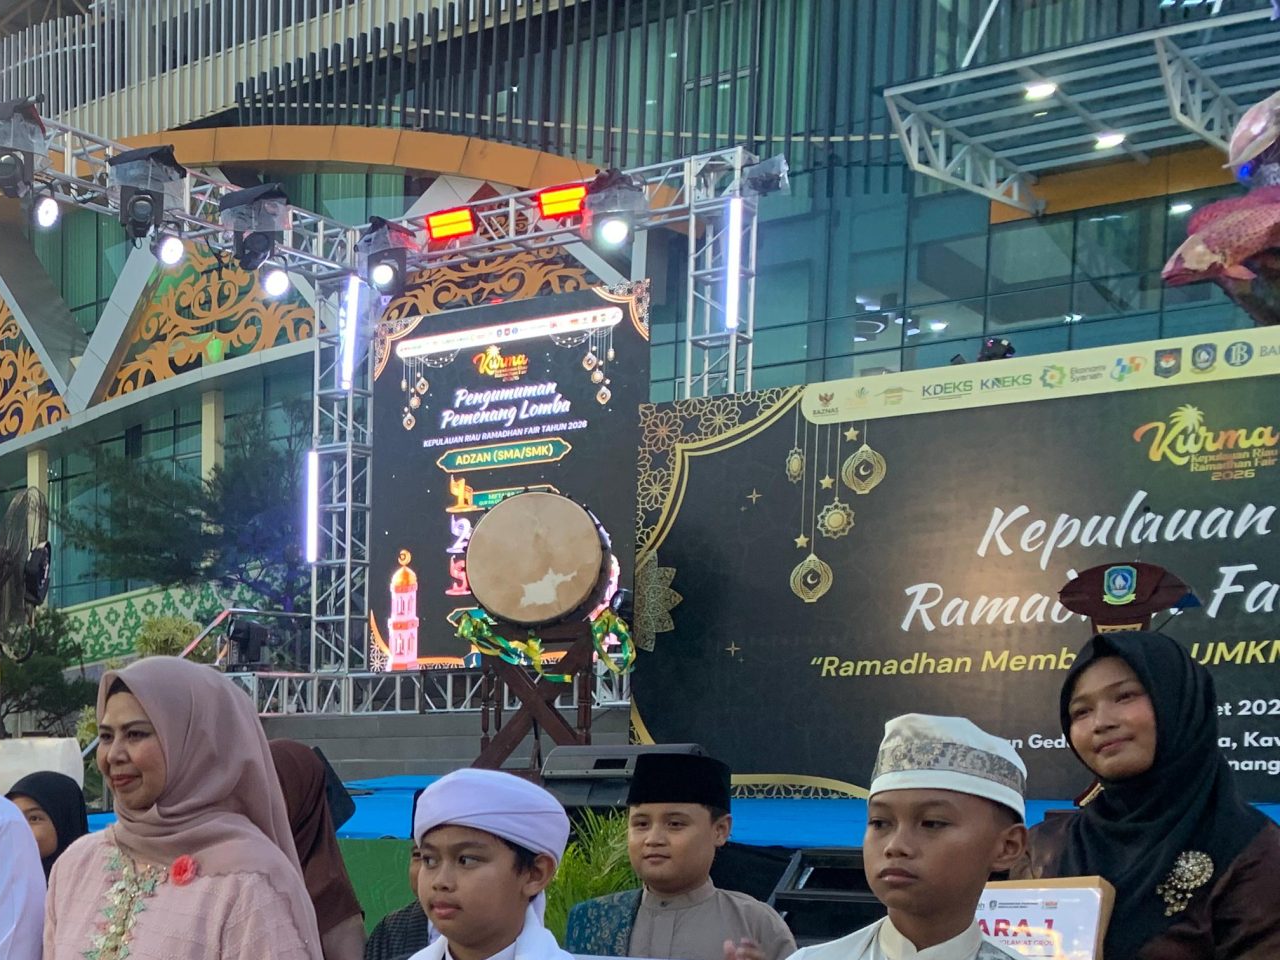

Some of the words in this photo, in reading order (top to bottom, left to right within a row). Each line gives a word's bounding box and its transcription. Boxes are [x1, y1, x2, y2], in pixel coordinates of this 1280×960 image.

[472, 352, 528, 375] Kurma
[453, 382, 558, 410] Pengumuman
[440, 405, 518, 429] Pemenang
[519, 393, 571, 419] Lomba
[541, 423, 567, 433] TAHUN
[455, 452, 492, 466] ADZAN
[493, 443, 554, 462] (SMA/SMK)
[1133, 421, 1280, 465] Kurma
[1211, 468, 1256, 480] 2026
[976, 489, 1278, 571] Kepulauan
